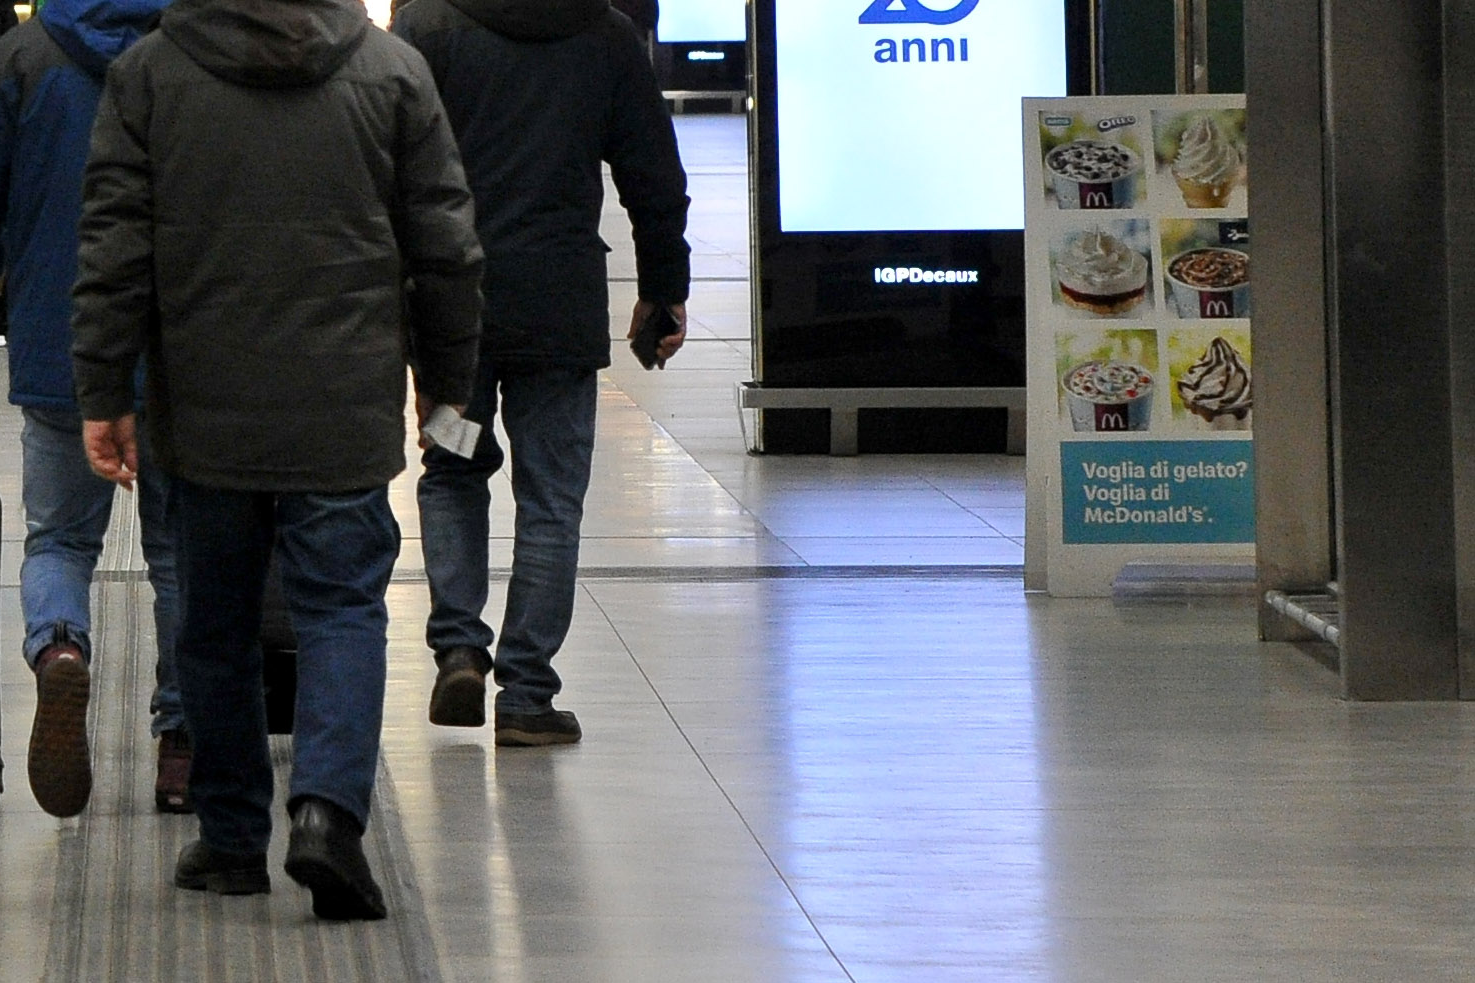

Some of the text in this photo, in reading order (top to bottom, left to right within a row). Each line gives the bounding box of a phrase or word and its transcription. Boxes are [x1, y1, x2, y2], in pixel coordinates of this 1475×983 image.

[873, 37, 969, 63] anni
[874, 267, 979, 283] IGPDecaux
[1081, 460, 1249, 483] Voglia di gelato?
[1083, 483, 1170, 506] Voglia di
